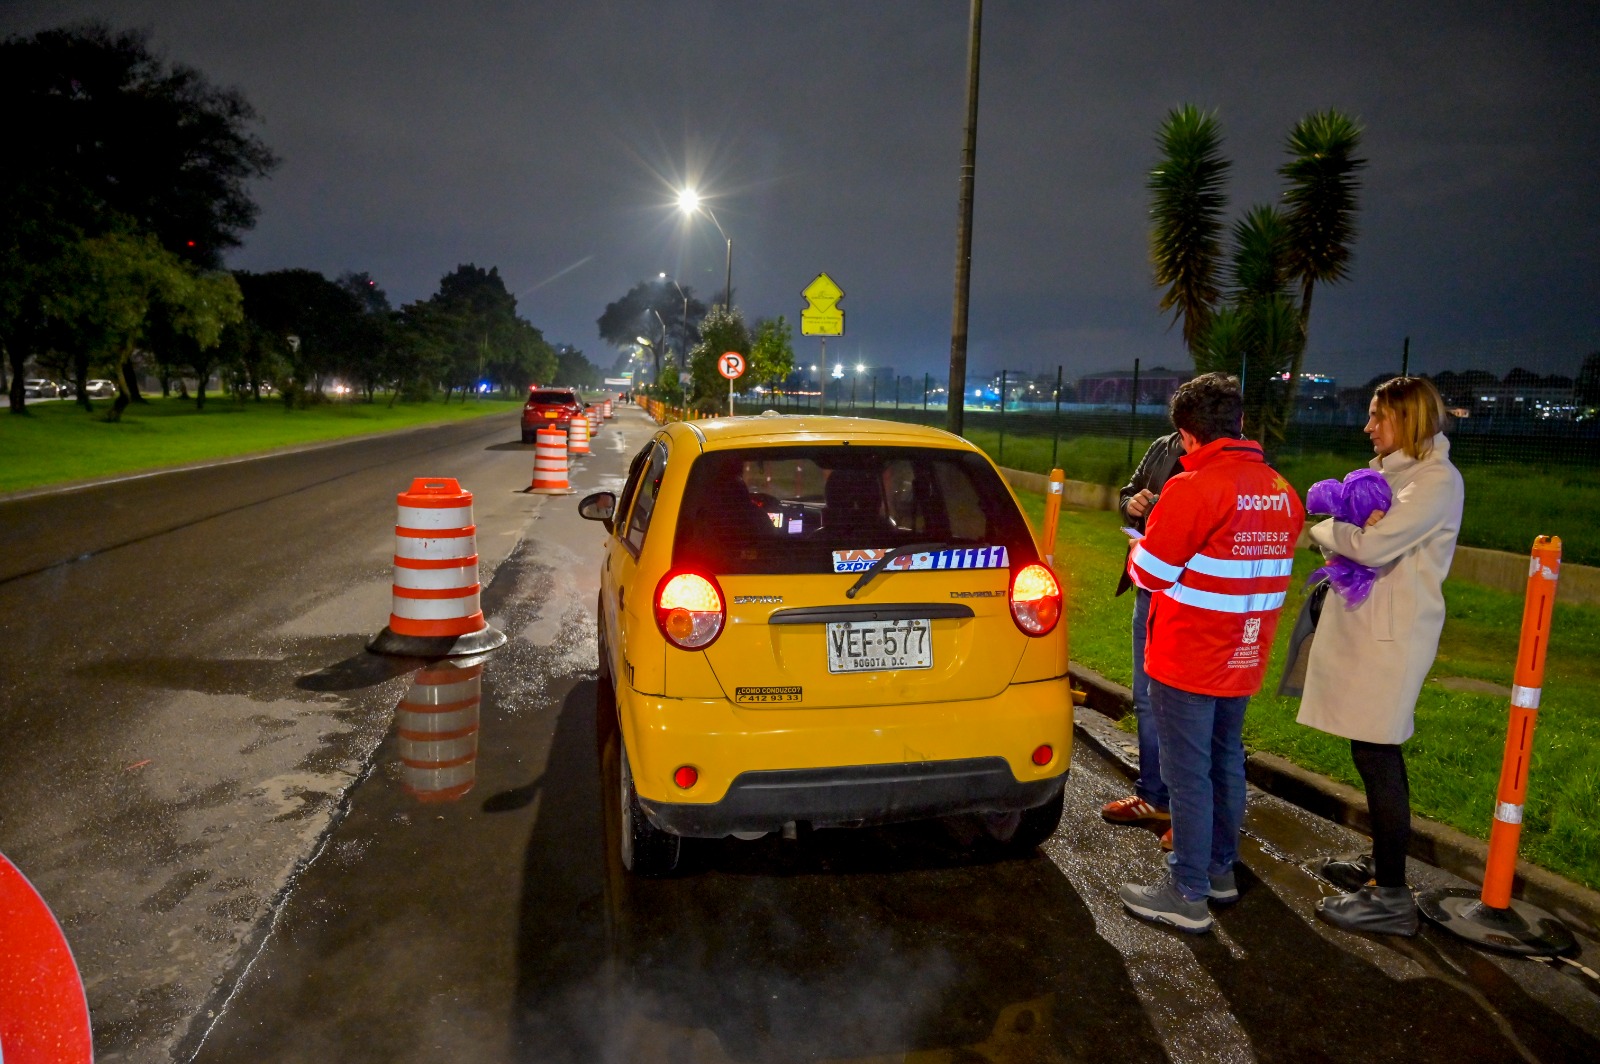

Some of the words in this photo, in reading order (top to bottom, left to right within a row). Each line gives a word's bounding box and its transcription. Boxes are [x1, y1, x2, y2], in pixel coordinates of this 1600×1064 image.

[1233, 531, 1278, 543] GESTORES
[1279, 531, 1290, 542] DE
[1231, 544, 1287, 556] CONVIVENCIA
[949, 590, 1007, 599] CHEVROLET
[733, 595, 784, 604] SPARK
[853, 658, 886, 668] BOGOTA
[761, 686, 801, 694] CONDUZCO?
